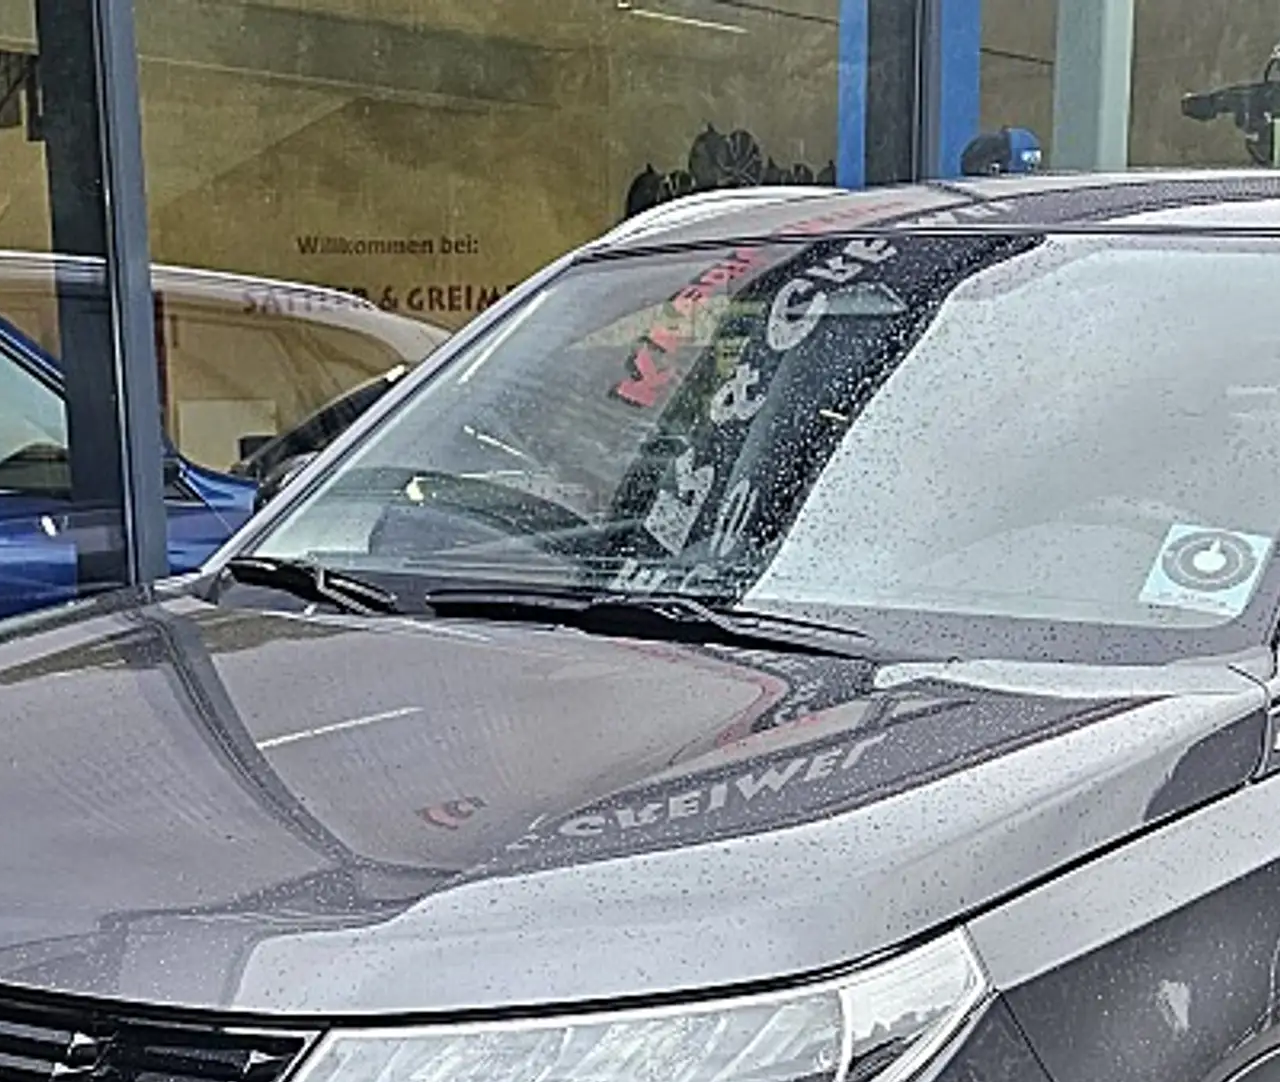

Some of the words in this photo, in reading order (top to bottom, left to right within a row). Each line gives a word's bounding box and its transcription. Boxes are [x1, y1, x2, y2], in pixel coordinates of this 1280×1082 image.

[297, 236, 434, 255] Willkommen
[440, 234, 479, 255] bei:
[378, 284, 400, 311] &
